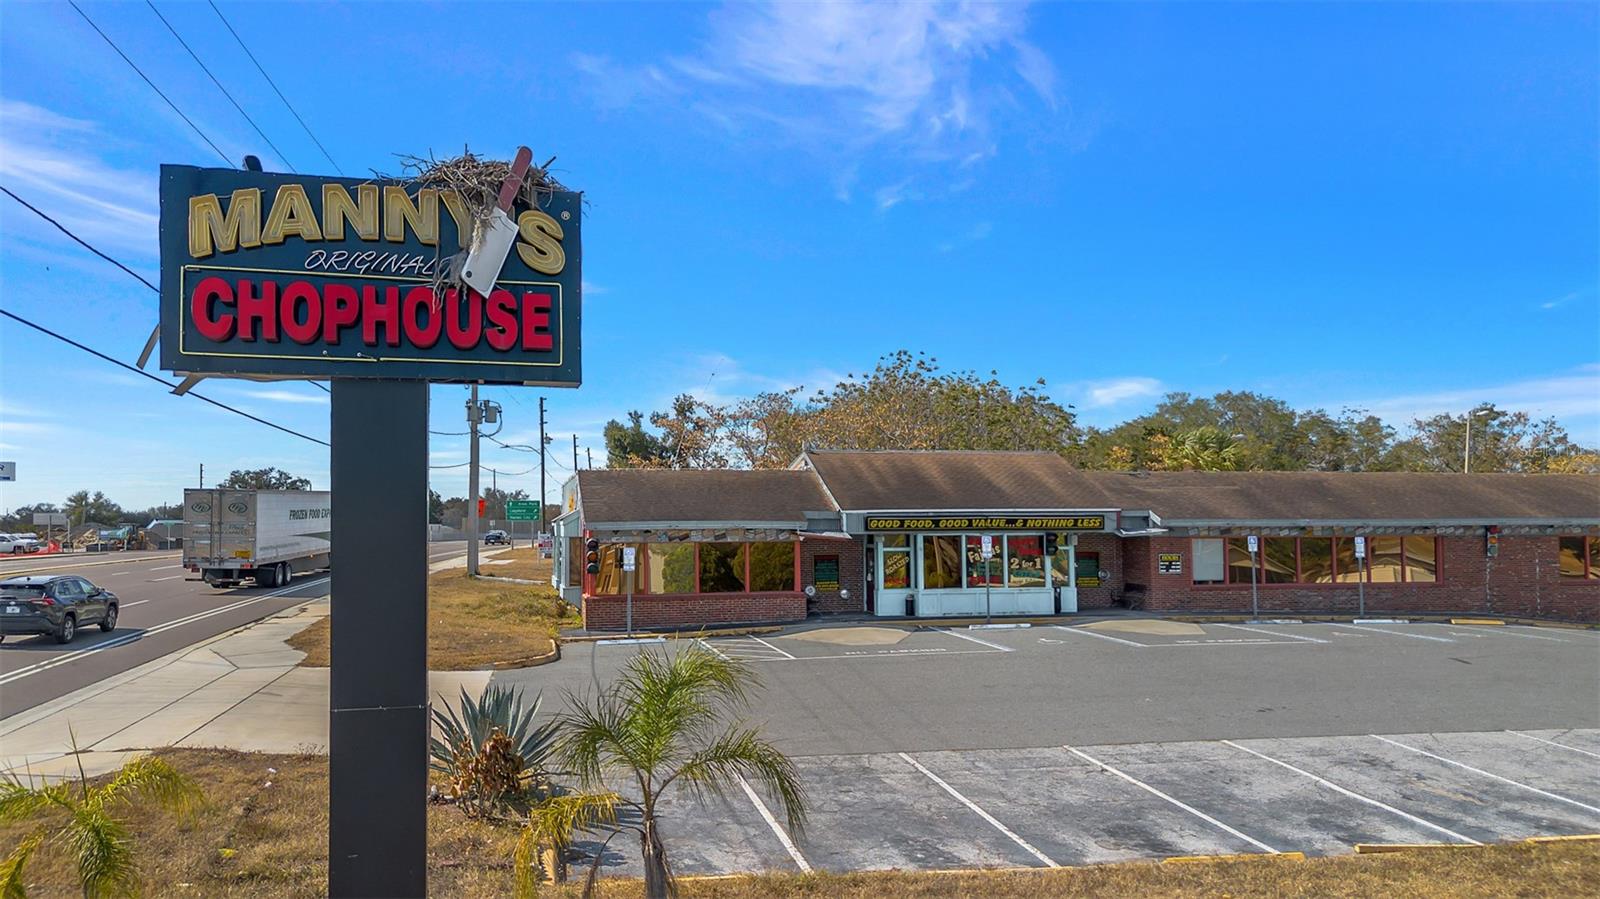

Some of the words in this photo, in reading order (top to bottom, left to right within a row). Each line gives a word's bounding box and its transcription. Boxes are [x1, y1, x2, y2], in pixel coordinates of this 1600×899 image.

[304, 249, 436, 275] ORIGINAL
[191, 277, 553, 351] CHOPHOUSE
[289, 509, 308, 520] FROZEN
[309, 508, 321, 520] FOOD
[870, 519, 901, 528] GOOD
[904, 519, 936, 529] FOOD,
[939, 519, 969, 528] GOOD
[1026, 519, 1074, 528] NOTHING
[1077, 518, 1101, 527] LESS
[1010, 558, 1020, 569] 2
[1022, 559, 1033, 568] for
[1034, 558, 1042, 569] 1
